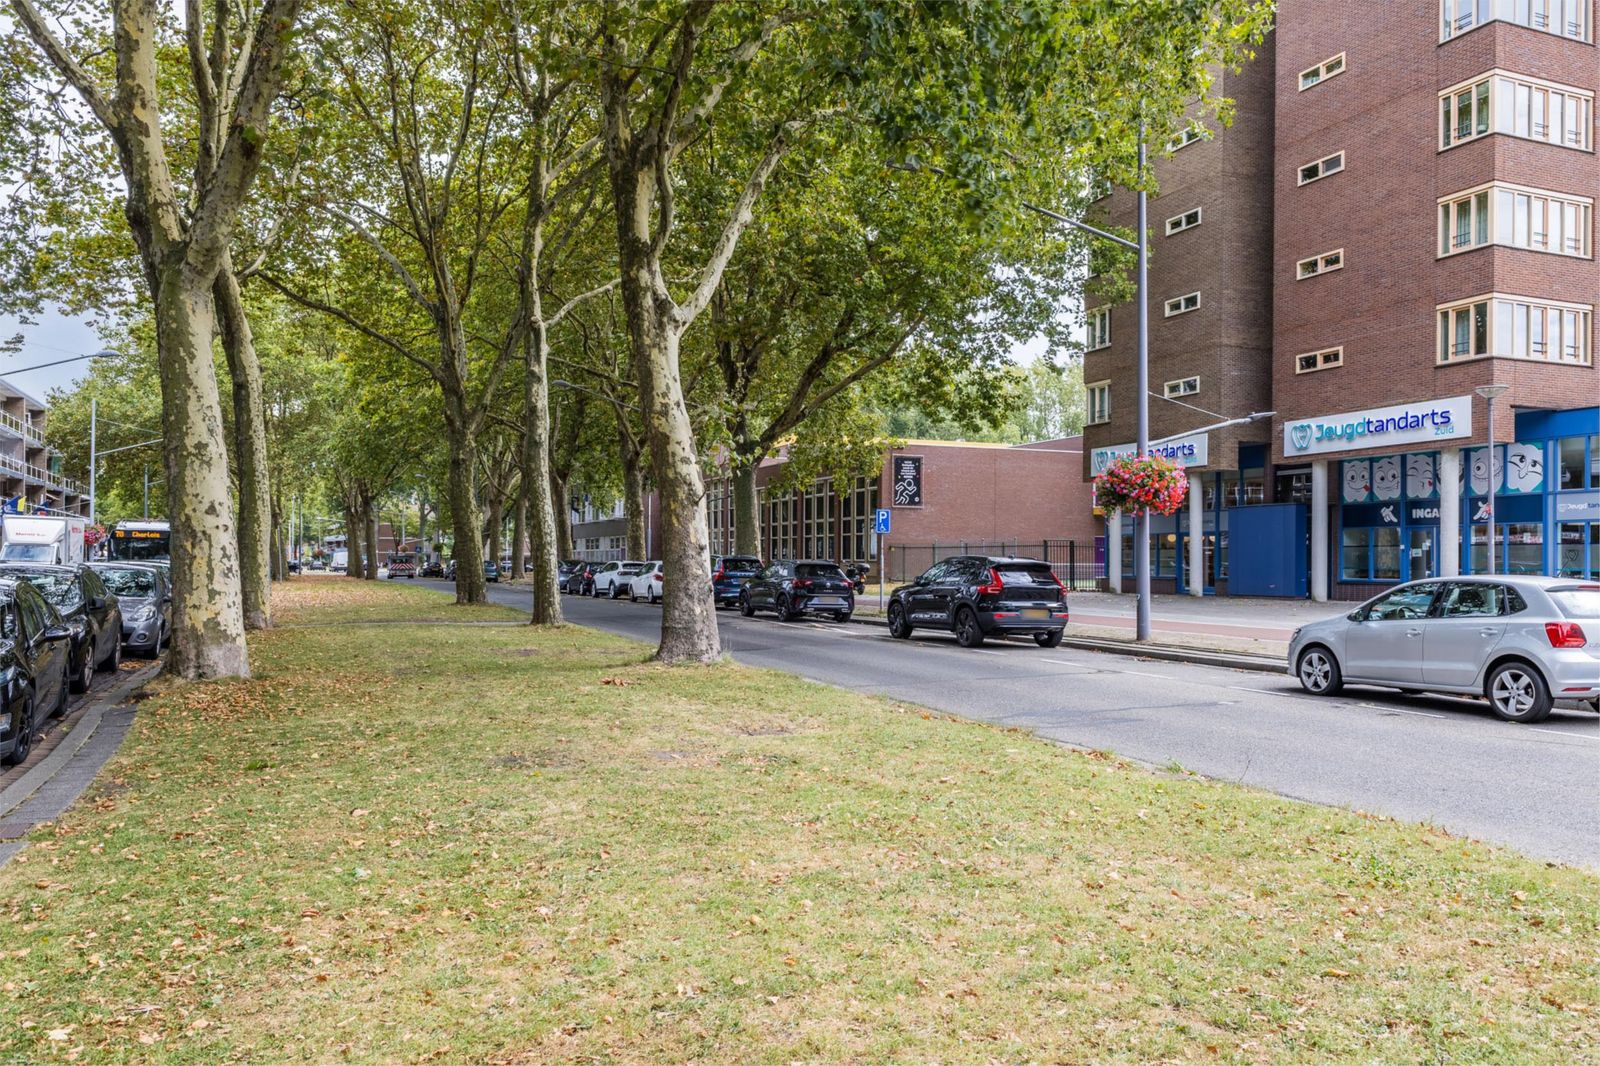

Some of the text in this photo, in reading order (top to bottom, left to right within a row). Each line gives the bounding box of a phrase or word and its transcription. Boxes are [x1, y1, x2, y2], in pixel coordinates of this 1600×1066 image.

[1315, 409, 1451, 441] Jeugdtandarts
[1434, 425, 1455, 436] Zuid
[879, 511, 888, 523] P
[1411, 507, 1440, 519] INGA
[115, 530, 125, 538] 70
